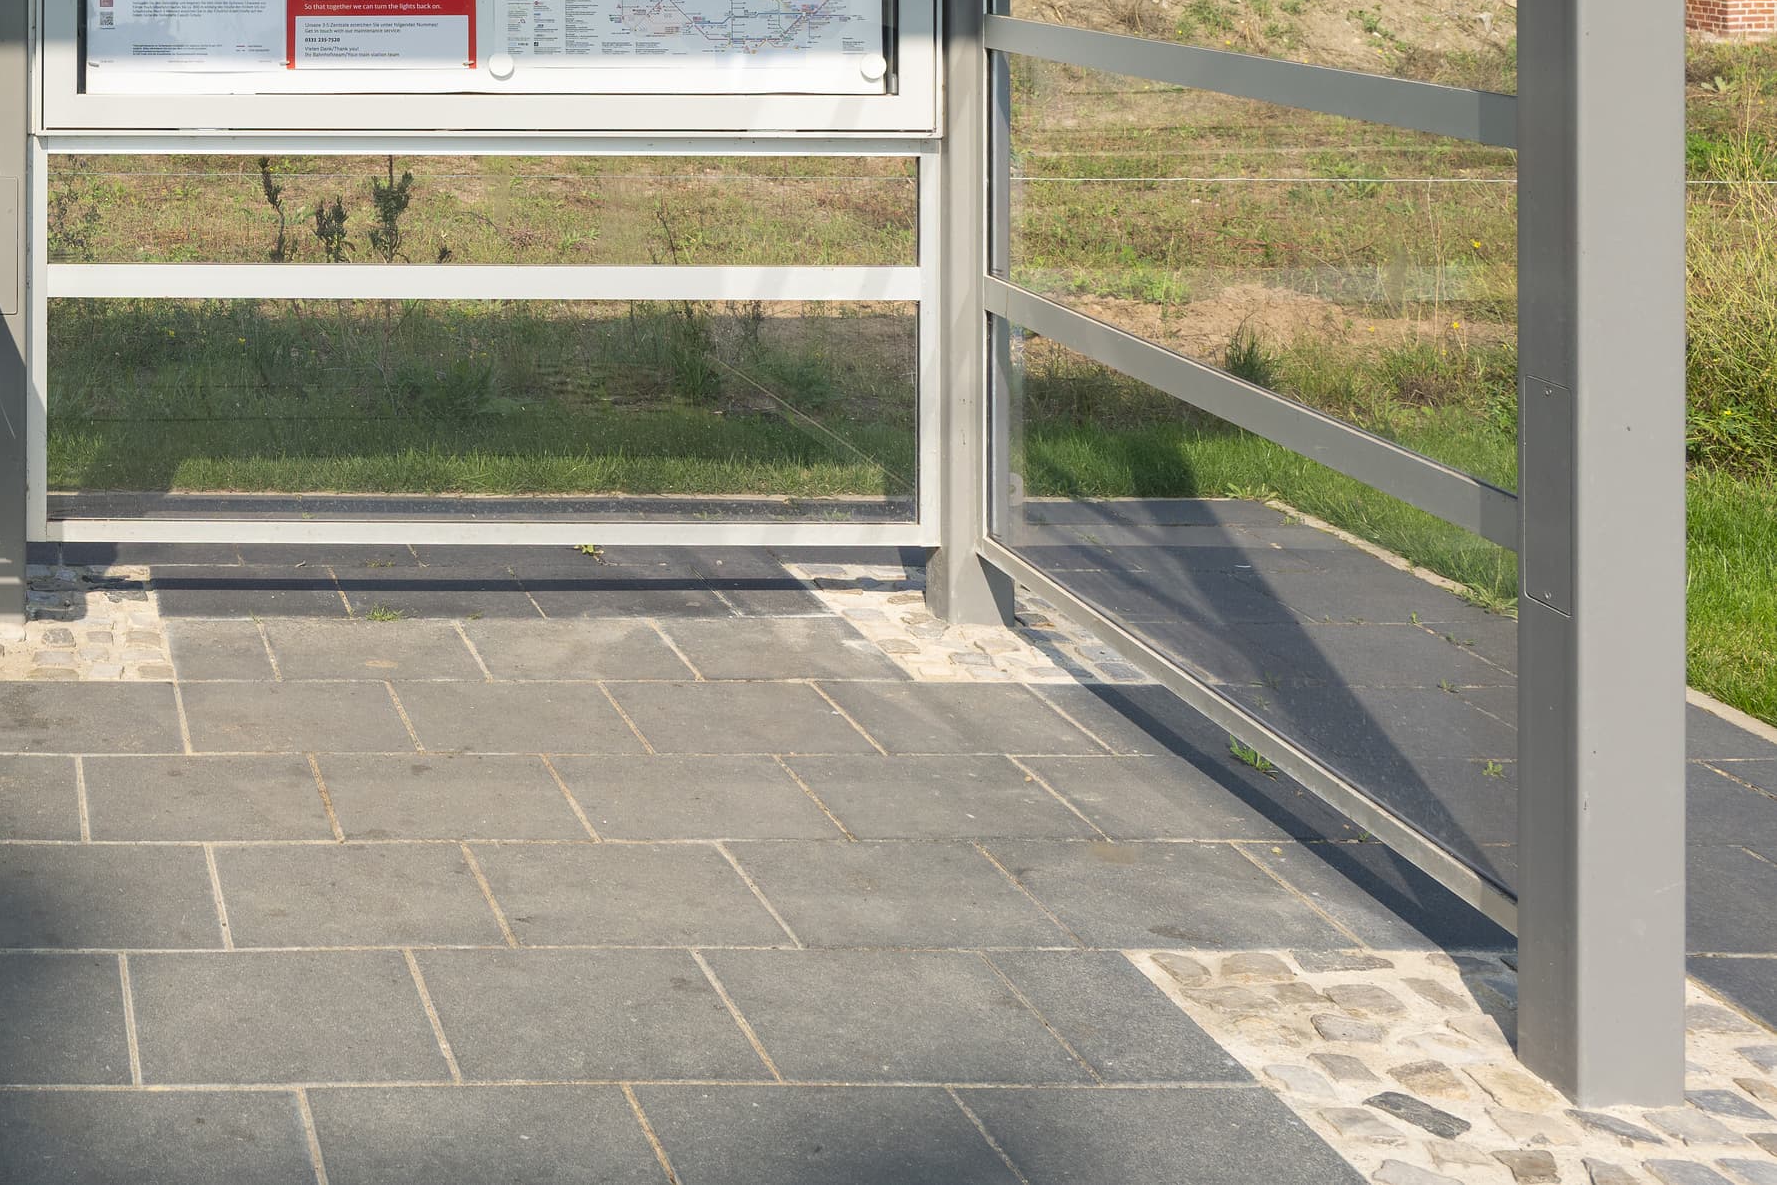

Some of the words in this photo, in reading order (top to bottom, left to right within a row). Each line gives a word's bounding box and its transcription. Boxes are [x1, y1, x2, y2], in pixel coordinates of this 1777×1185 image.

[304, 3, 312, 11] So
[313, 3, 326, 11] that
[326, 3, 352, 11] together
[374, 3, 388, 11] turn
[388, 3, 398, 11] the
[399, 3, 416, 11] lights
[416, 3, 430, 11] back
